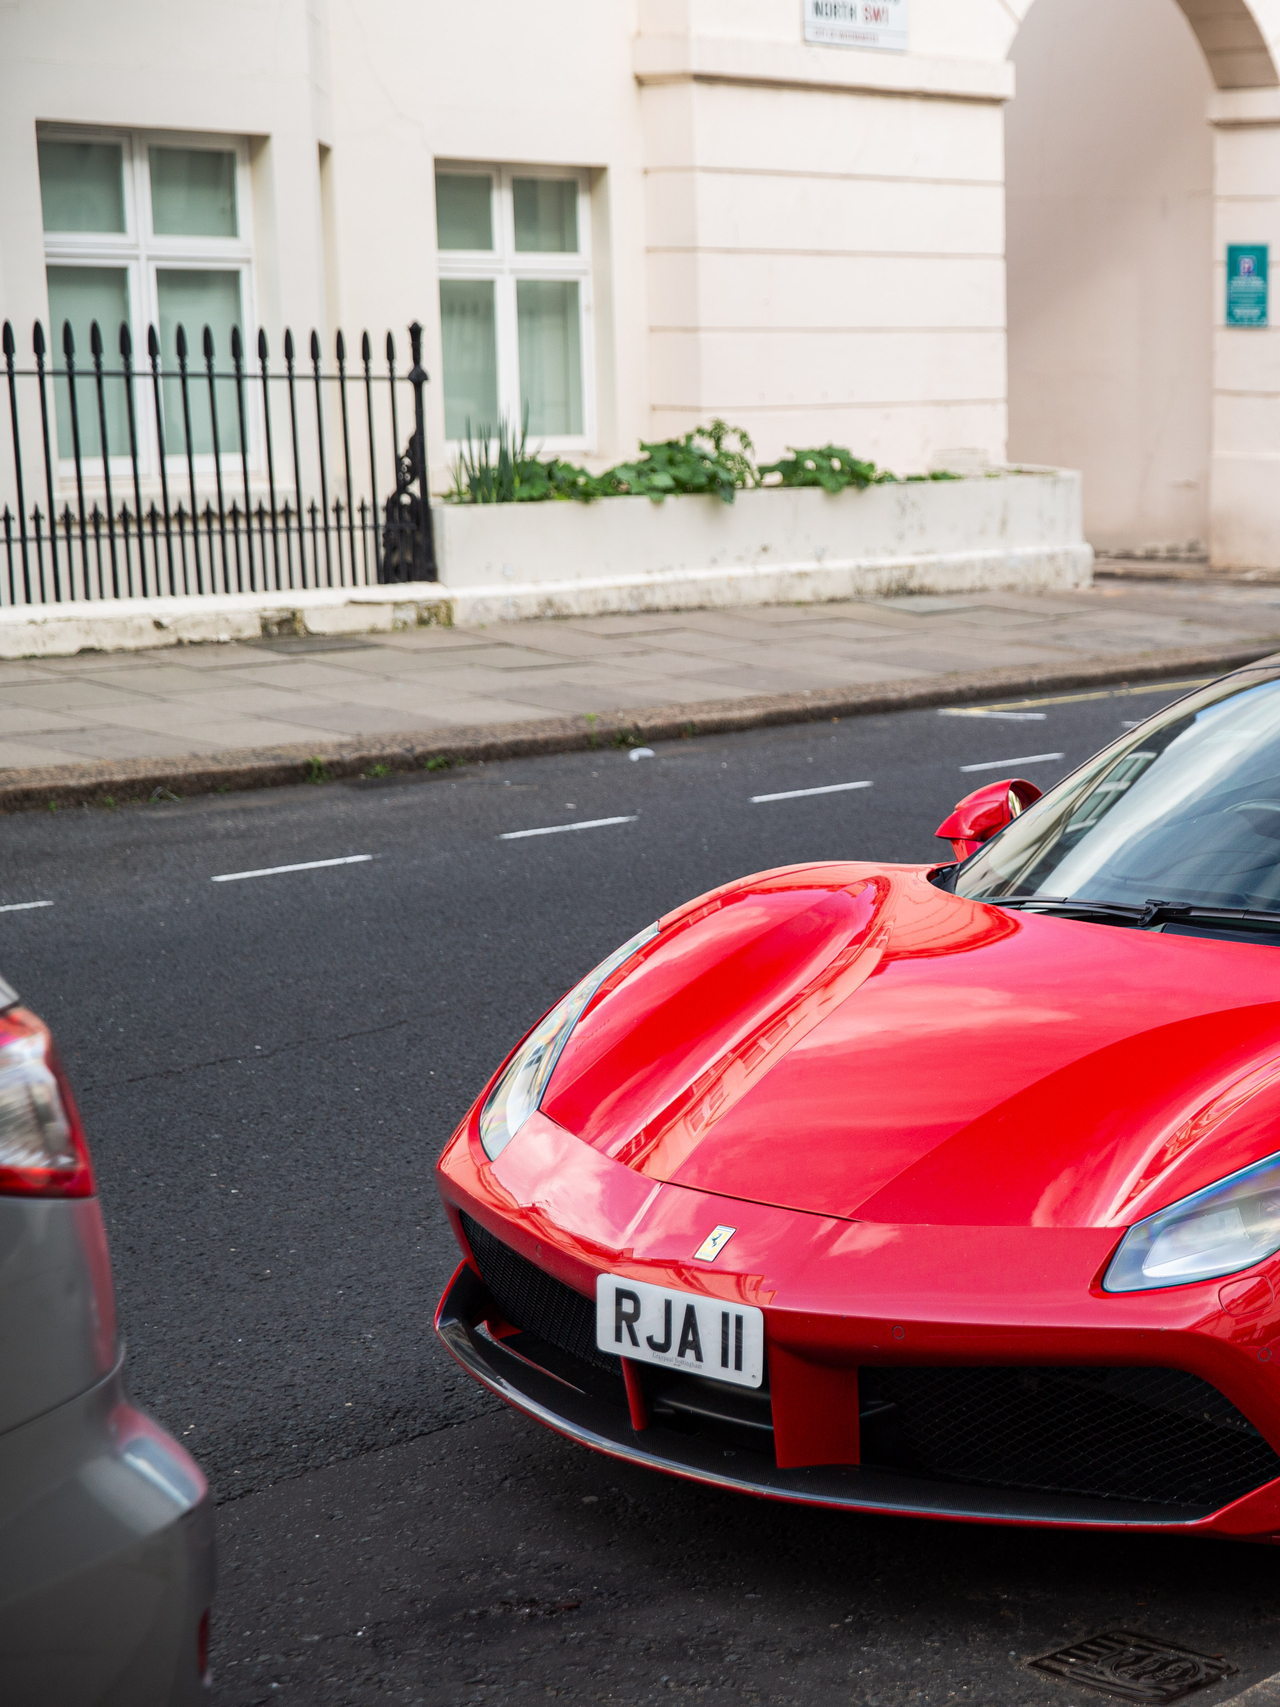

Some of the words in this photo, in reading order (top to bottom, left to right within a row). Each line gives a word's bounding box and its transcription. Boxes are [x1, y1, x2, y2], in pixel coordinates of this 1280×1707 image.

[813, 1, 857, 22] NORTH
[614, 1287, 704, 1363] RJA
[674, 1357, 703, 1369] Nottingham
